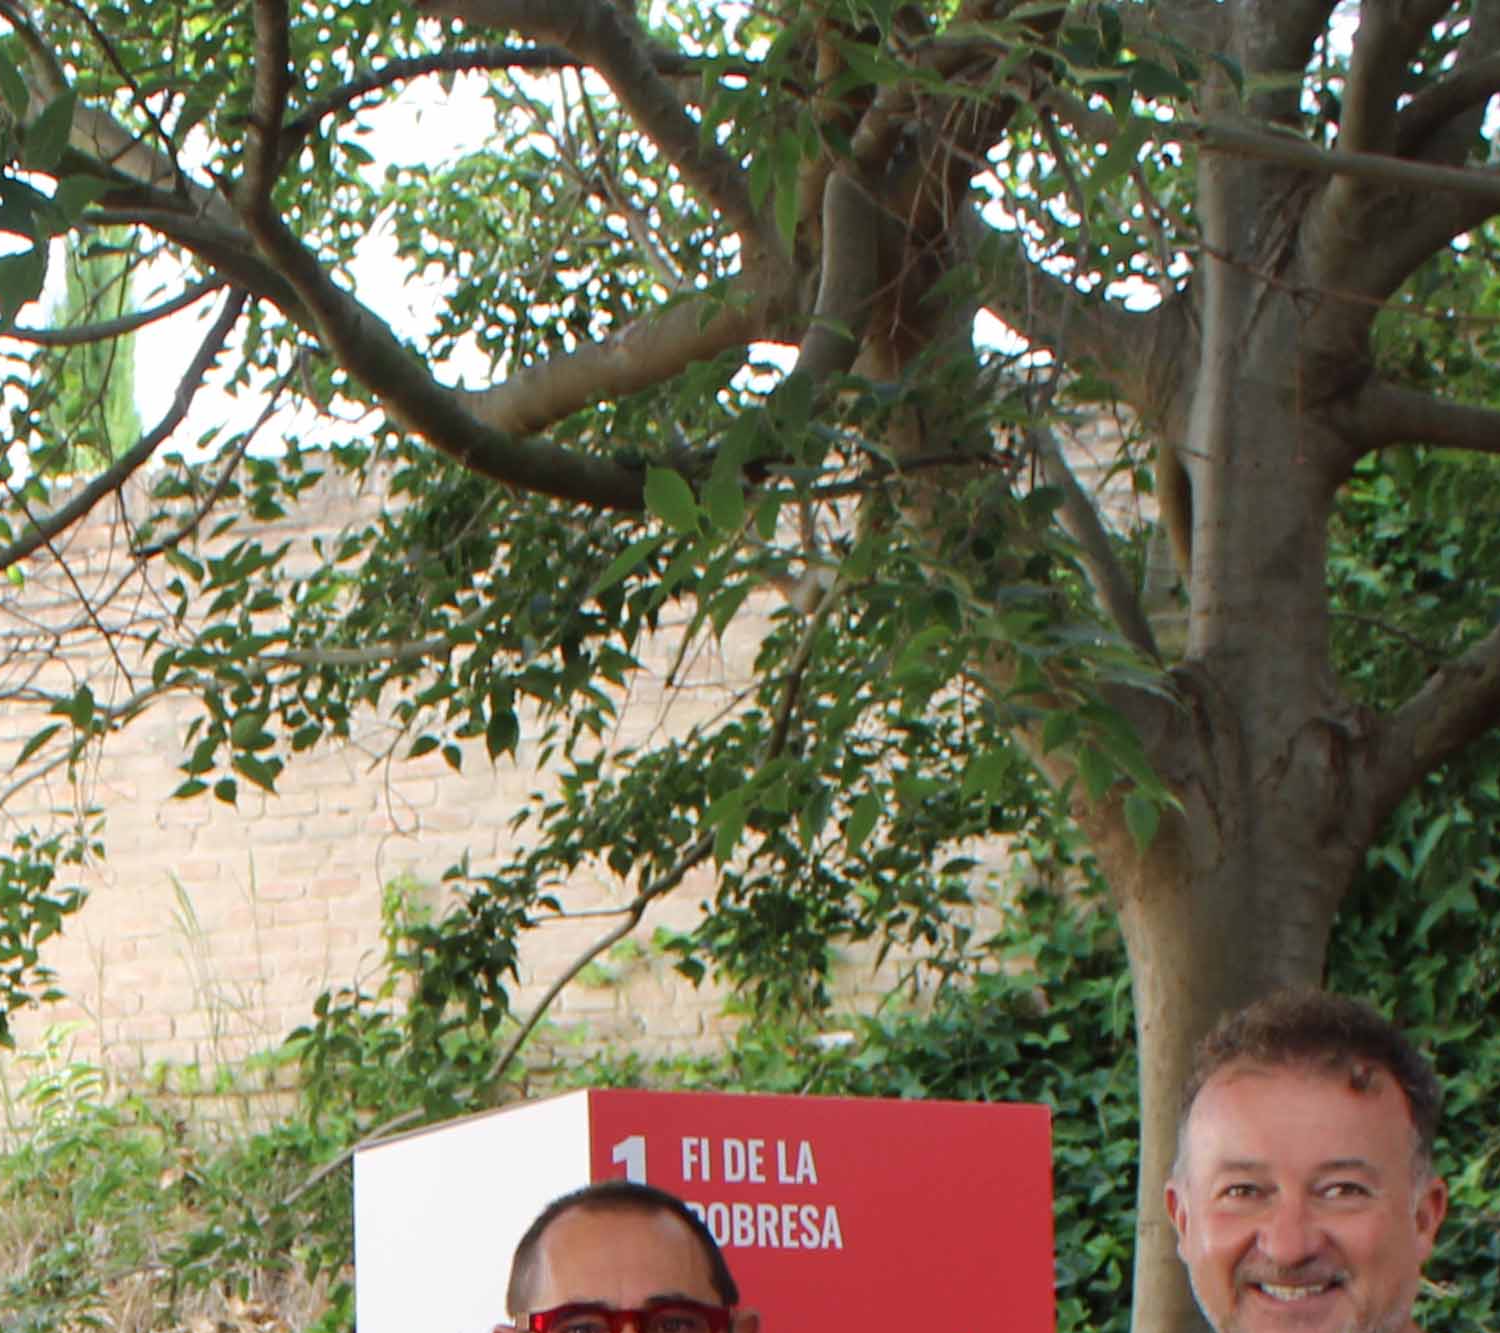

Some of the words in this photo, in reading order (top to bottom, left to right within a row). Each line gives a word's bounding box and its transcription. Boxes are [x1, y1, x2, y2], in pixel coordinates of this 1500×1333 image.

[682, 1136, 710, 1182] FI
[723, 1138, 766, 1183] DE
[777, 1139, 818, 1185] LA
